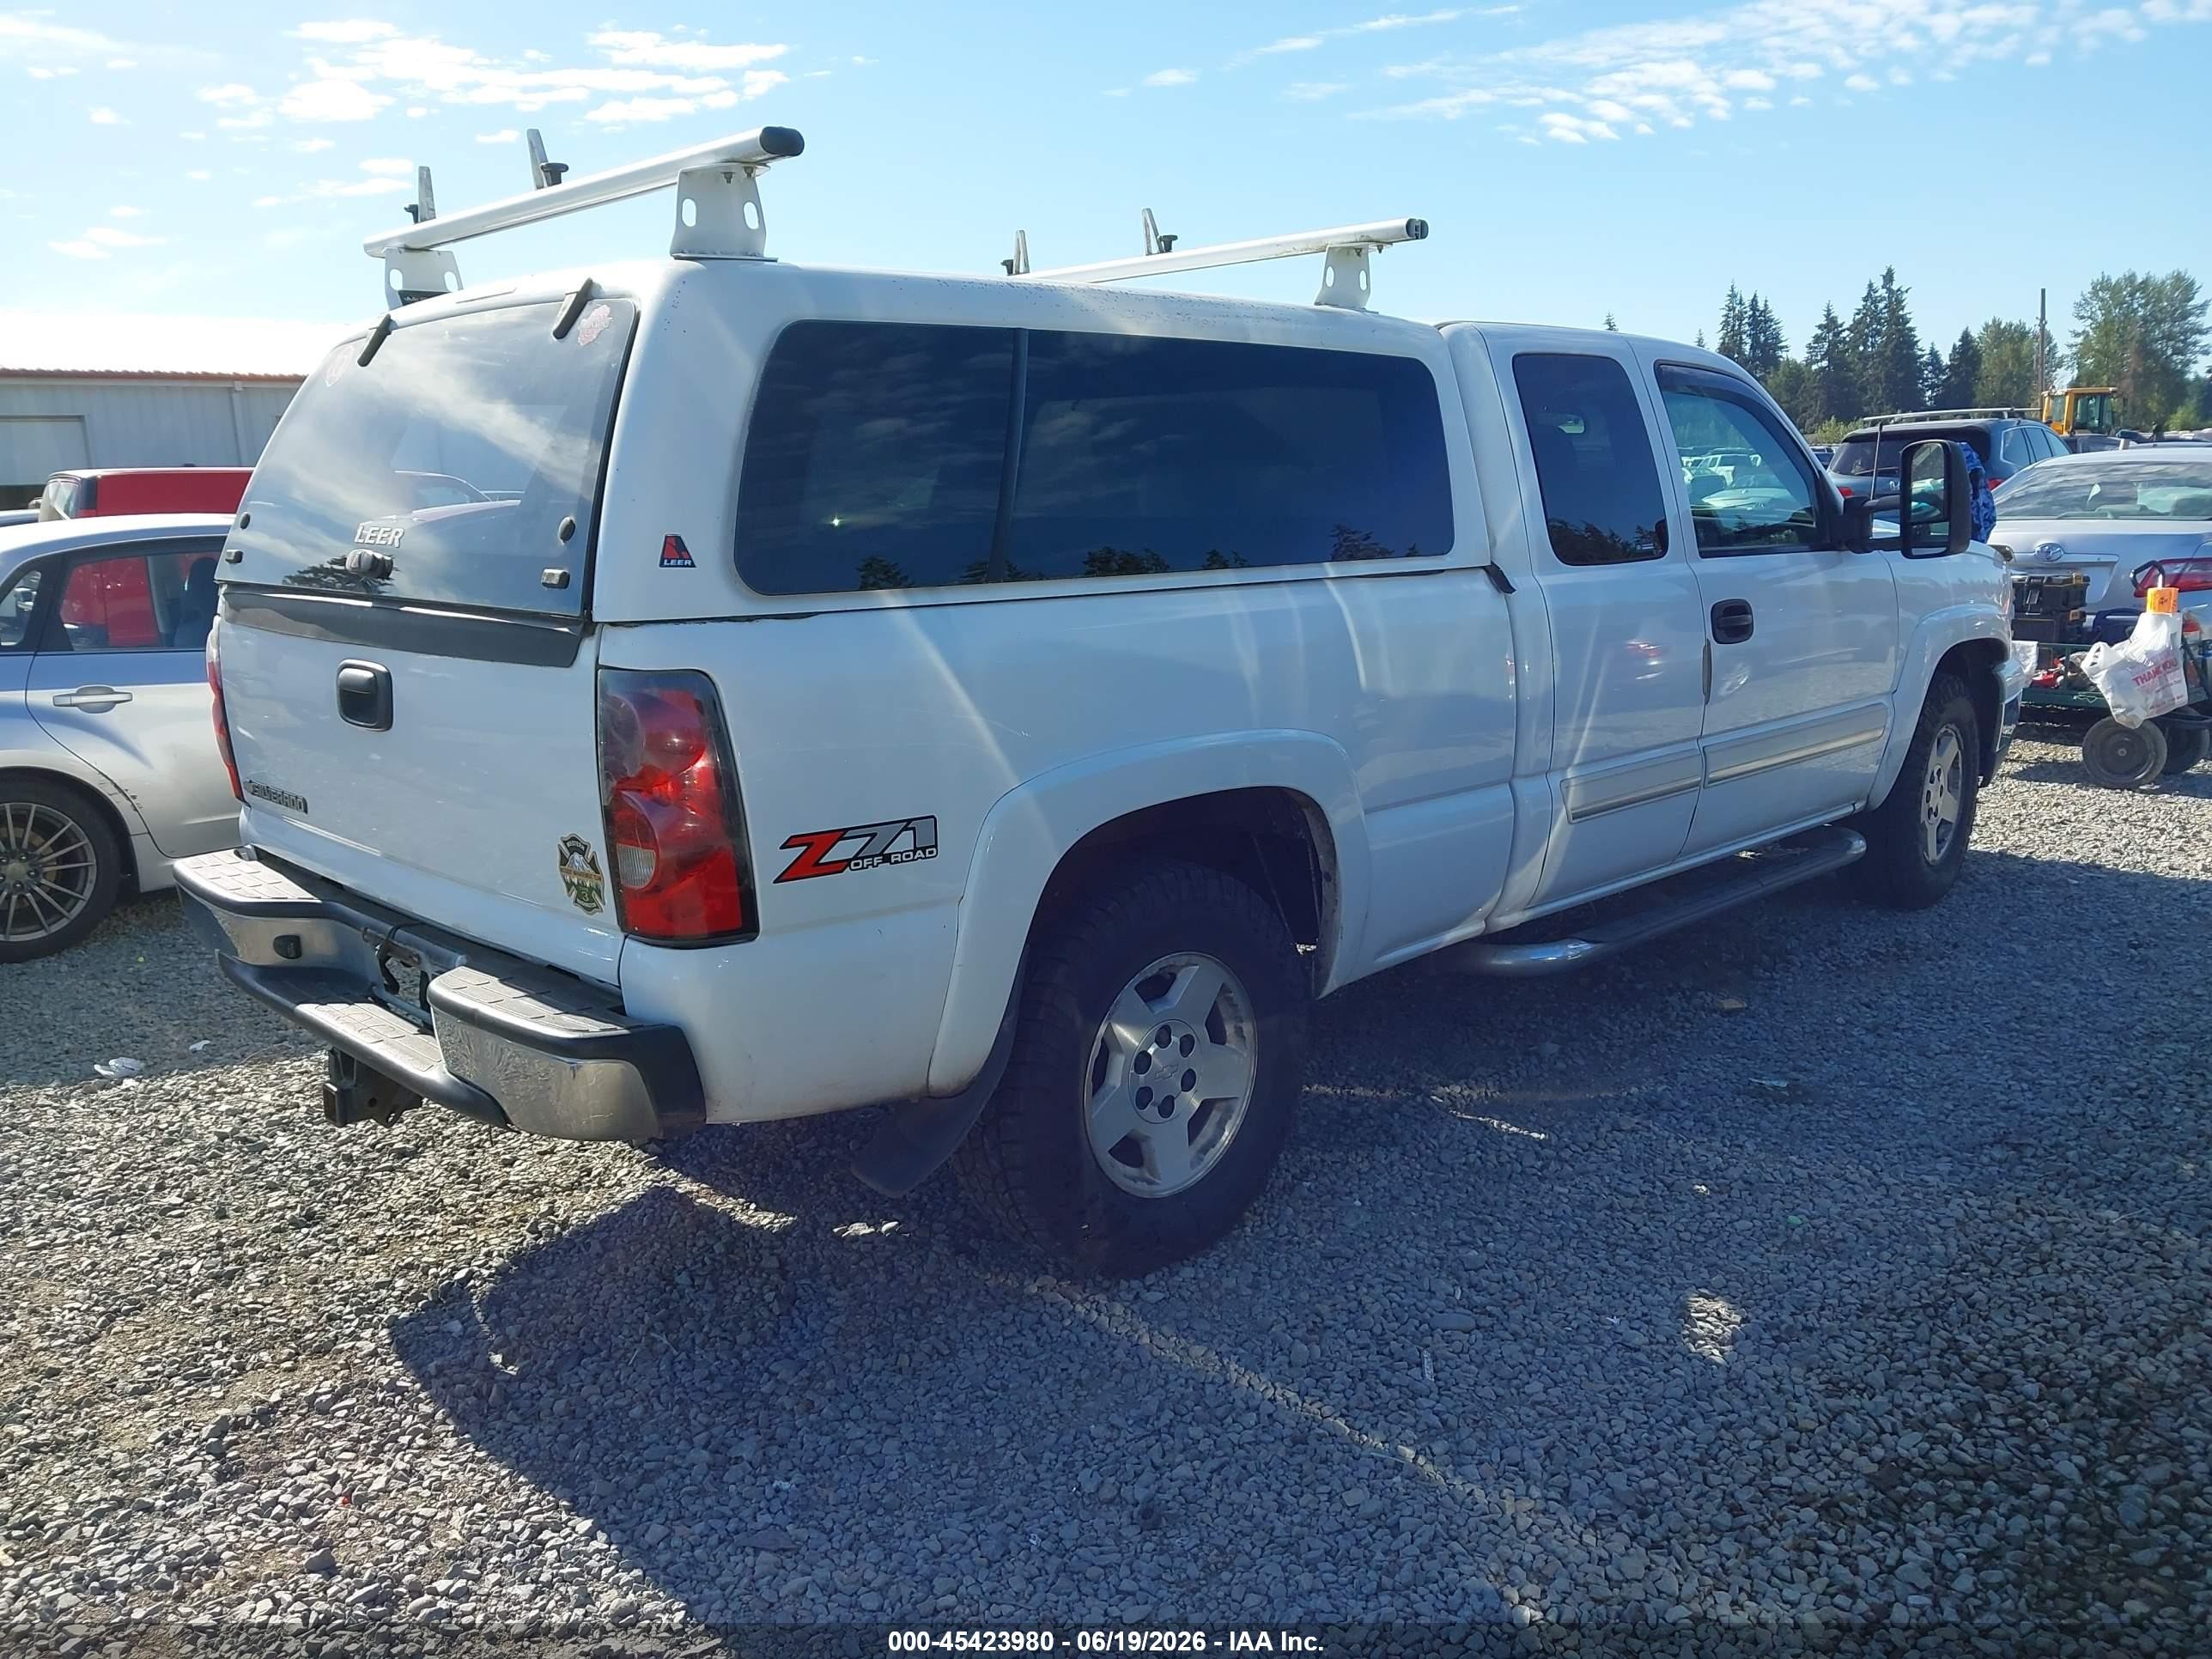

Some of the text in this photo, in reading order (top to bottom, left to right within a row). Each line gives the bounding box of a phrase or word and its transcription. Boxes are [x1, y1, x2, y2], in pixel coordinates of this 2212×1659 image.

[355, 526, 404, 548] LEER
[2132, 665, 2163, 686] THANK
[252, 782, 306, 811] SILVERADO
[773, 815, 938, 884] Z71
[849, 848, 938, 871] OFF ROAD
[582, 890, 589, 902] 3
